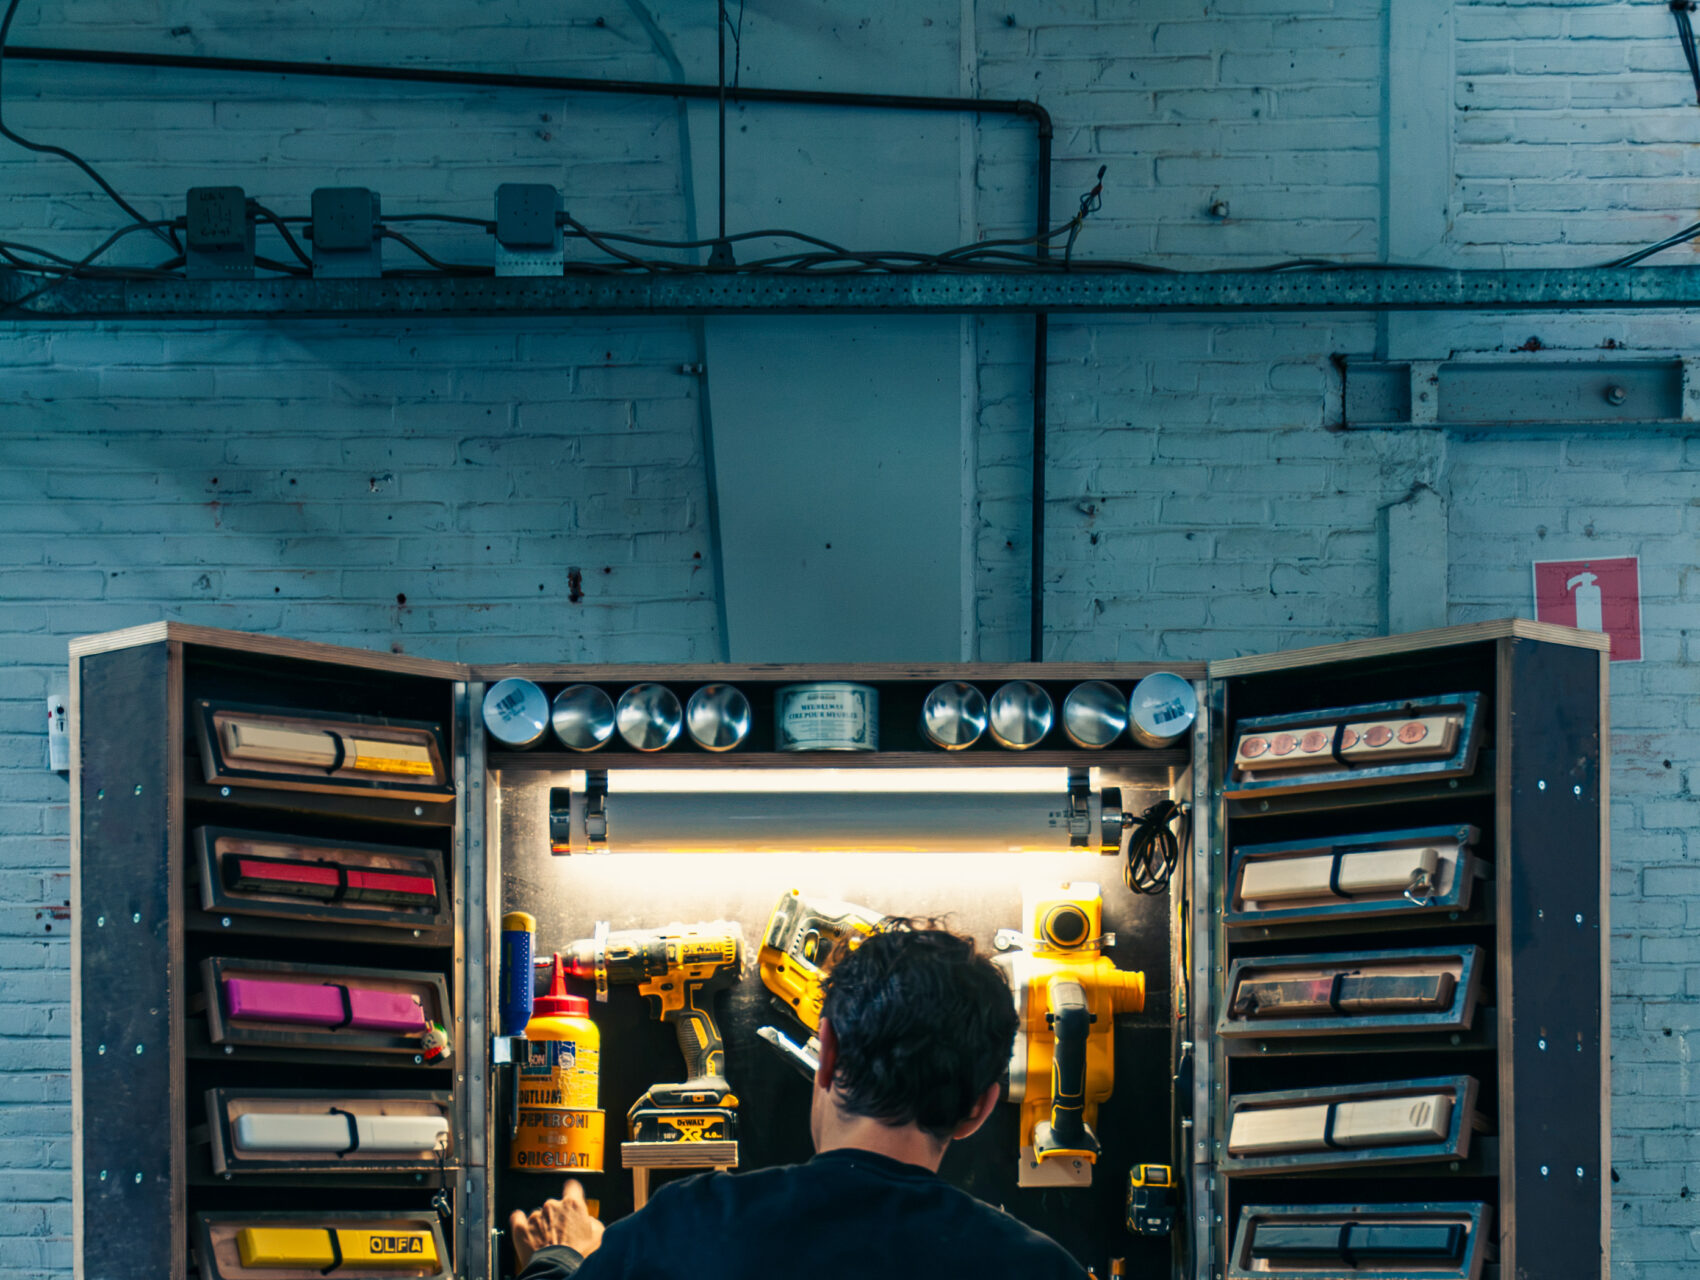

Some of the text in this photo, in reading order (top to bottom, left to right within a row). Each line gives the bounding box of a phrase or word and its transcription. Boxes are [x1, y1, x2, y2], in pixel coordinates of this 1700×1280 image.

[519, 1113, 589, 1129] PEPERONI
[518, 1151, 590, 1168] GRIGLIATI
[370, 1236, 423, 1253] OLFA
